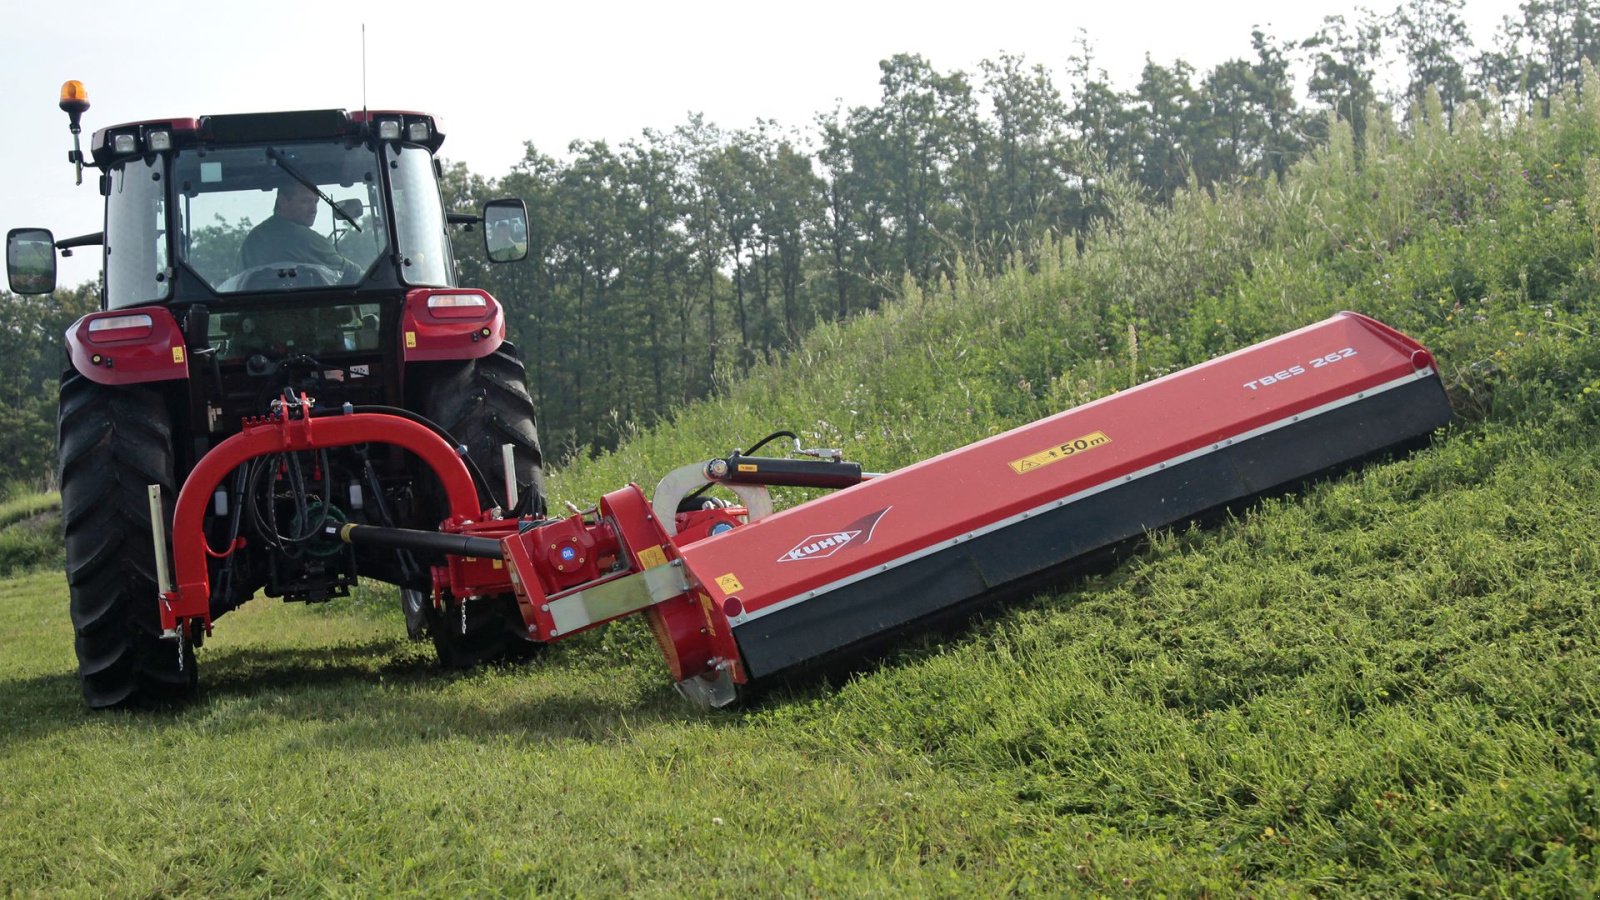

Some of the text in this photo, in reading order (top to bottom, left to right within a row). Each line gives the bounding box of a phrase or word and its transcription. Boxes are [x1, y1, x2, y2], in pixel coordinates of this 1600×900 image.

[1242, 347, 1358, 390] TBES 262
[1060, 436, 1105, 455] 50 m
[562, 549, 574, 559] OIL
[787, 532, 852, 560] KUHN
